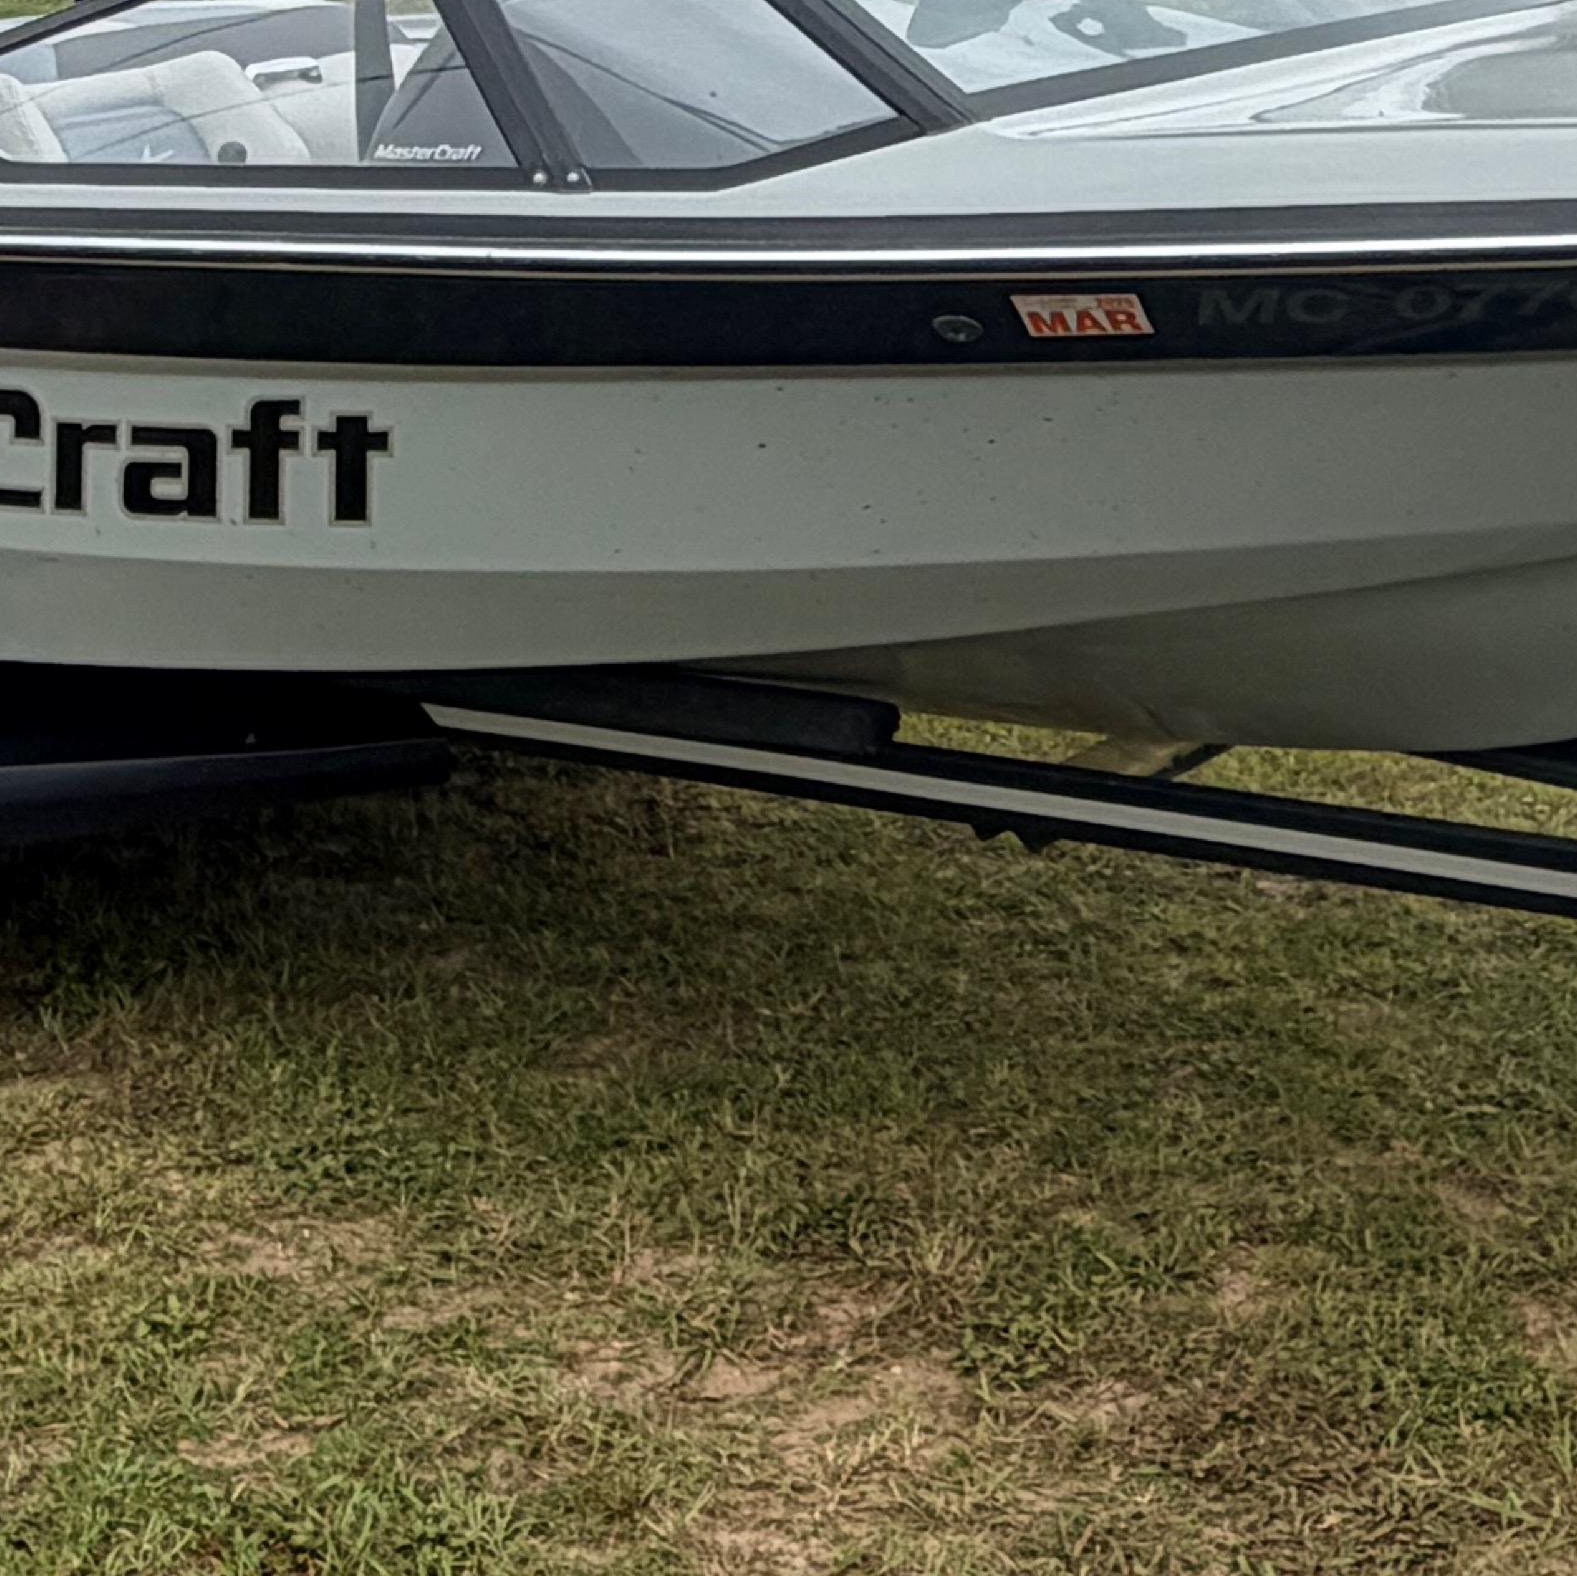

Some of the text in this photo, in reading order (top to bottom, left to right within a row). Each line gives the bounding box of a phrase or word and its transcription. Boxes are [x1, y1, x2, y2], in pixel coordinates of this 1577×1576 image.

[374, 143, 483, 161] MasterCraft
[1199, 287, 1350, 326] MC
[1026, 309, 1145, 333] MAR
